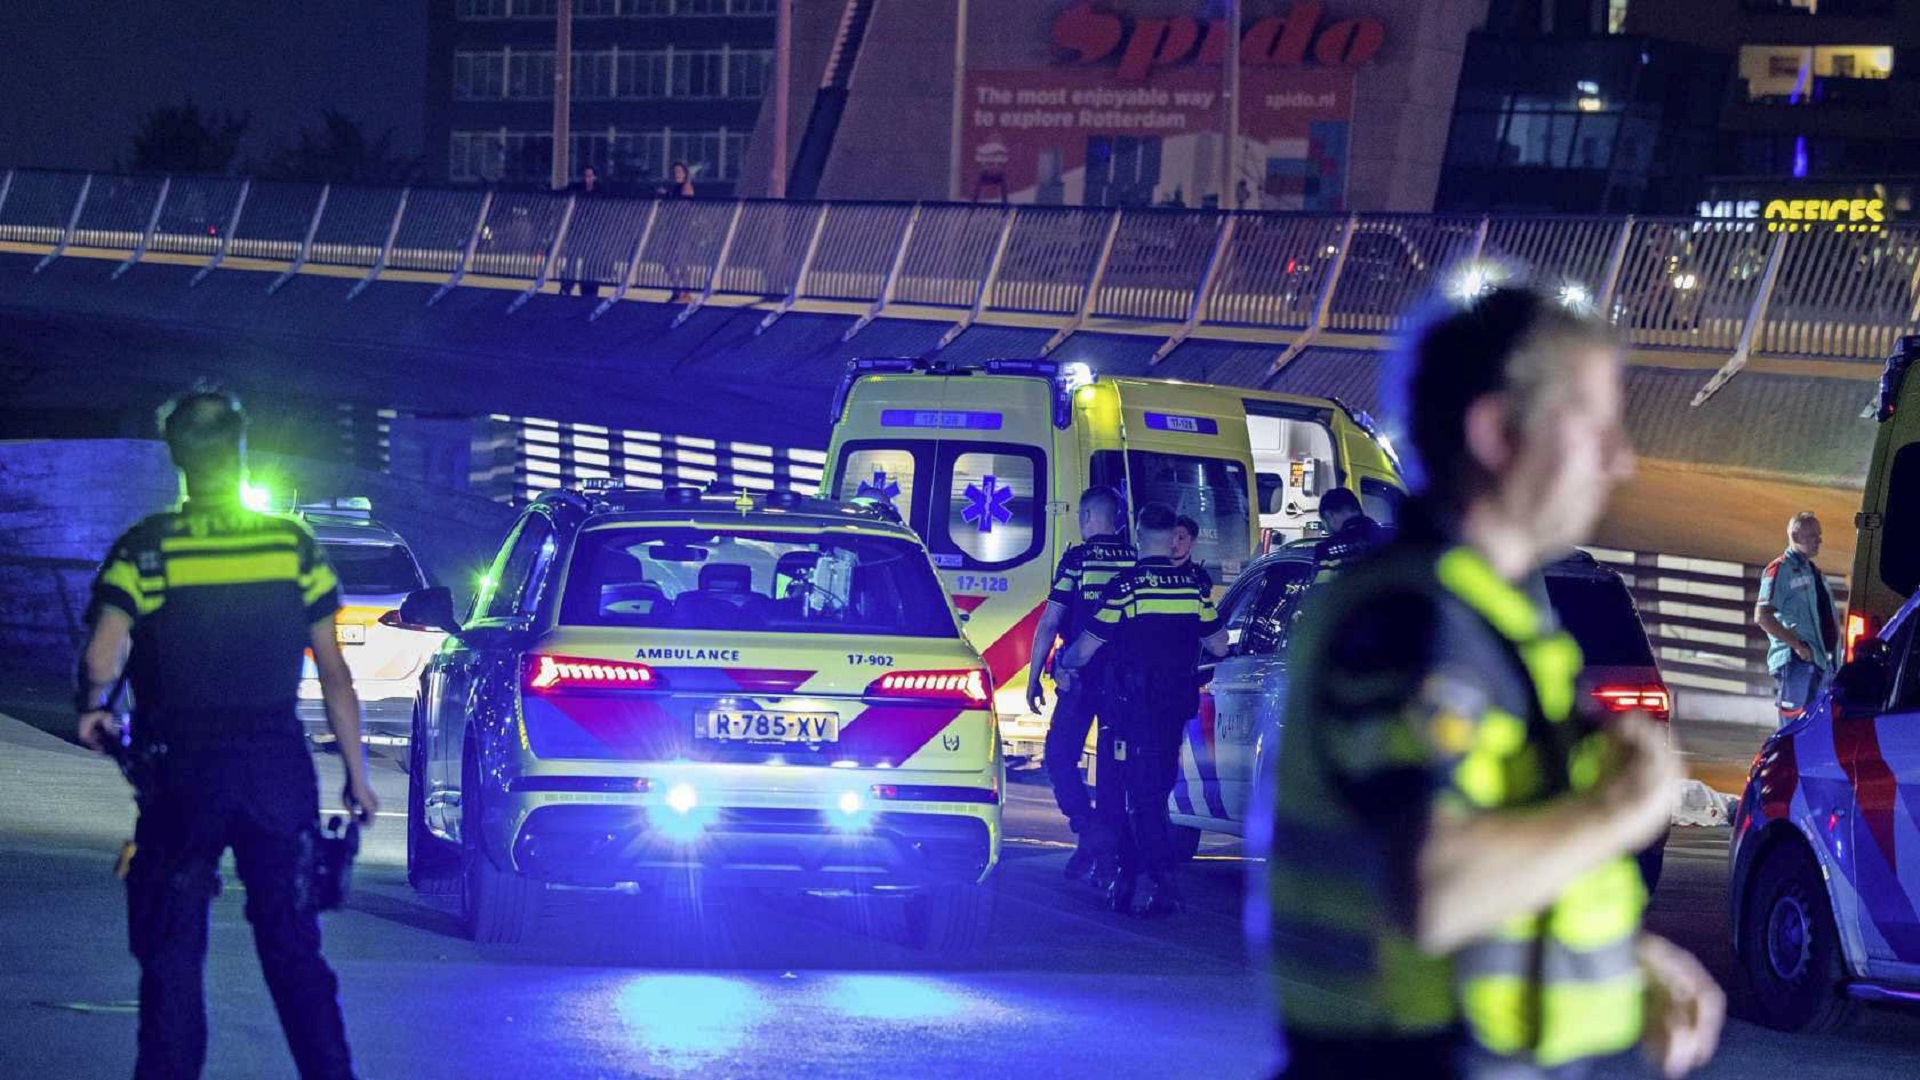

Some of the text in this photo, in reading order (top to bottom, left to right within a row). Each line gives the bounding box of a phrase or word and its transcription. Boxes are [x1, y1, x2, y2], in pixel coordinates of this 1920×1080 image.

[1052, 0, 1386, 80] Spido
[976, 87, 1215, 109] The most enjoyable way
[1264, 91, 1337, 109] spido.nl
[974, 109, 1186, 129] to explore Rotterdam
[1764, 198, 1885, 233] OFFICES
[957, 576, 1008, 592] 17-128
[636, 648, 740, 661] AMBULANCE
[847, 653, 895, 667] 17-902
[716, 713, 828, 737] R-785-XV
